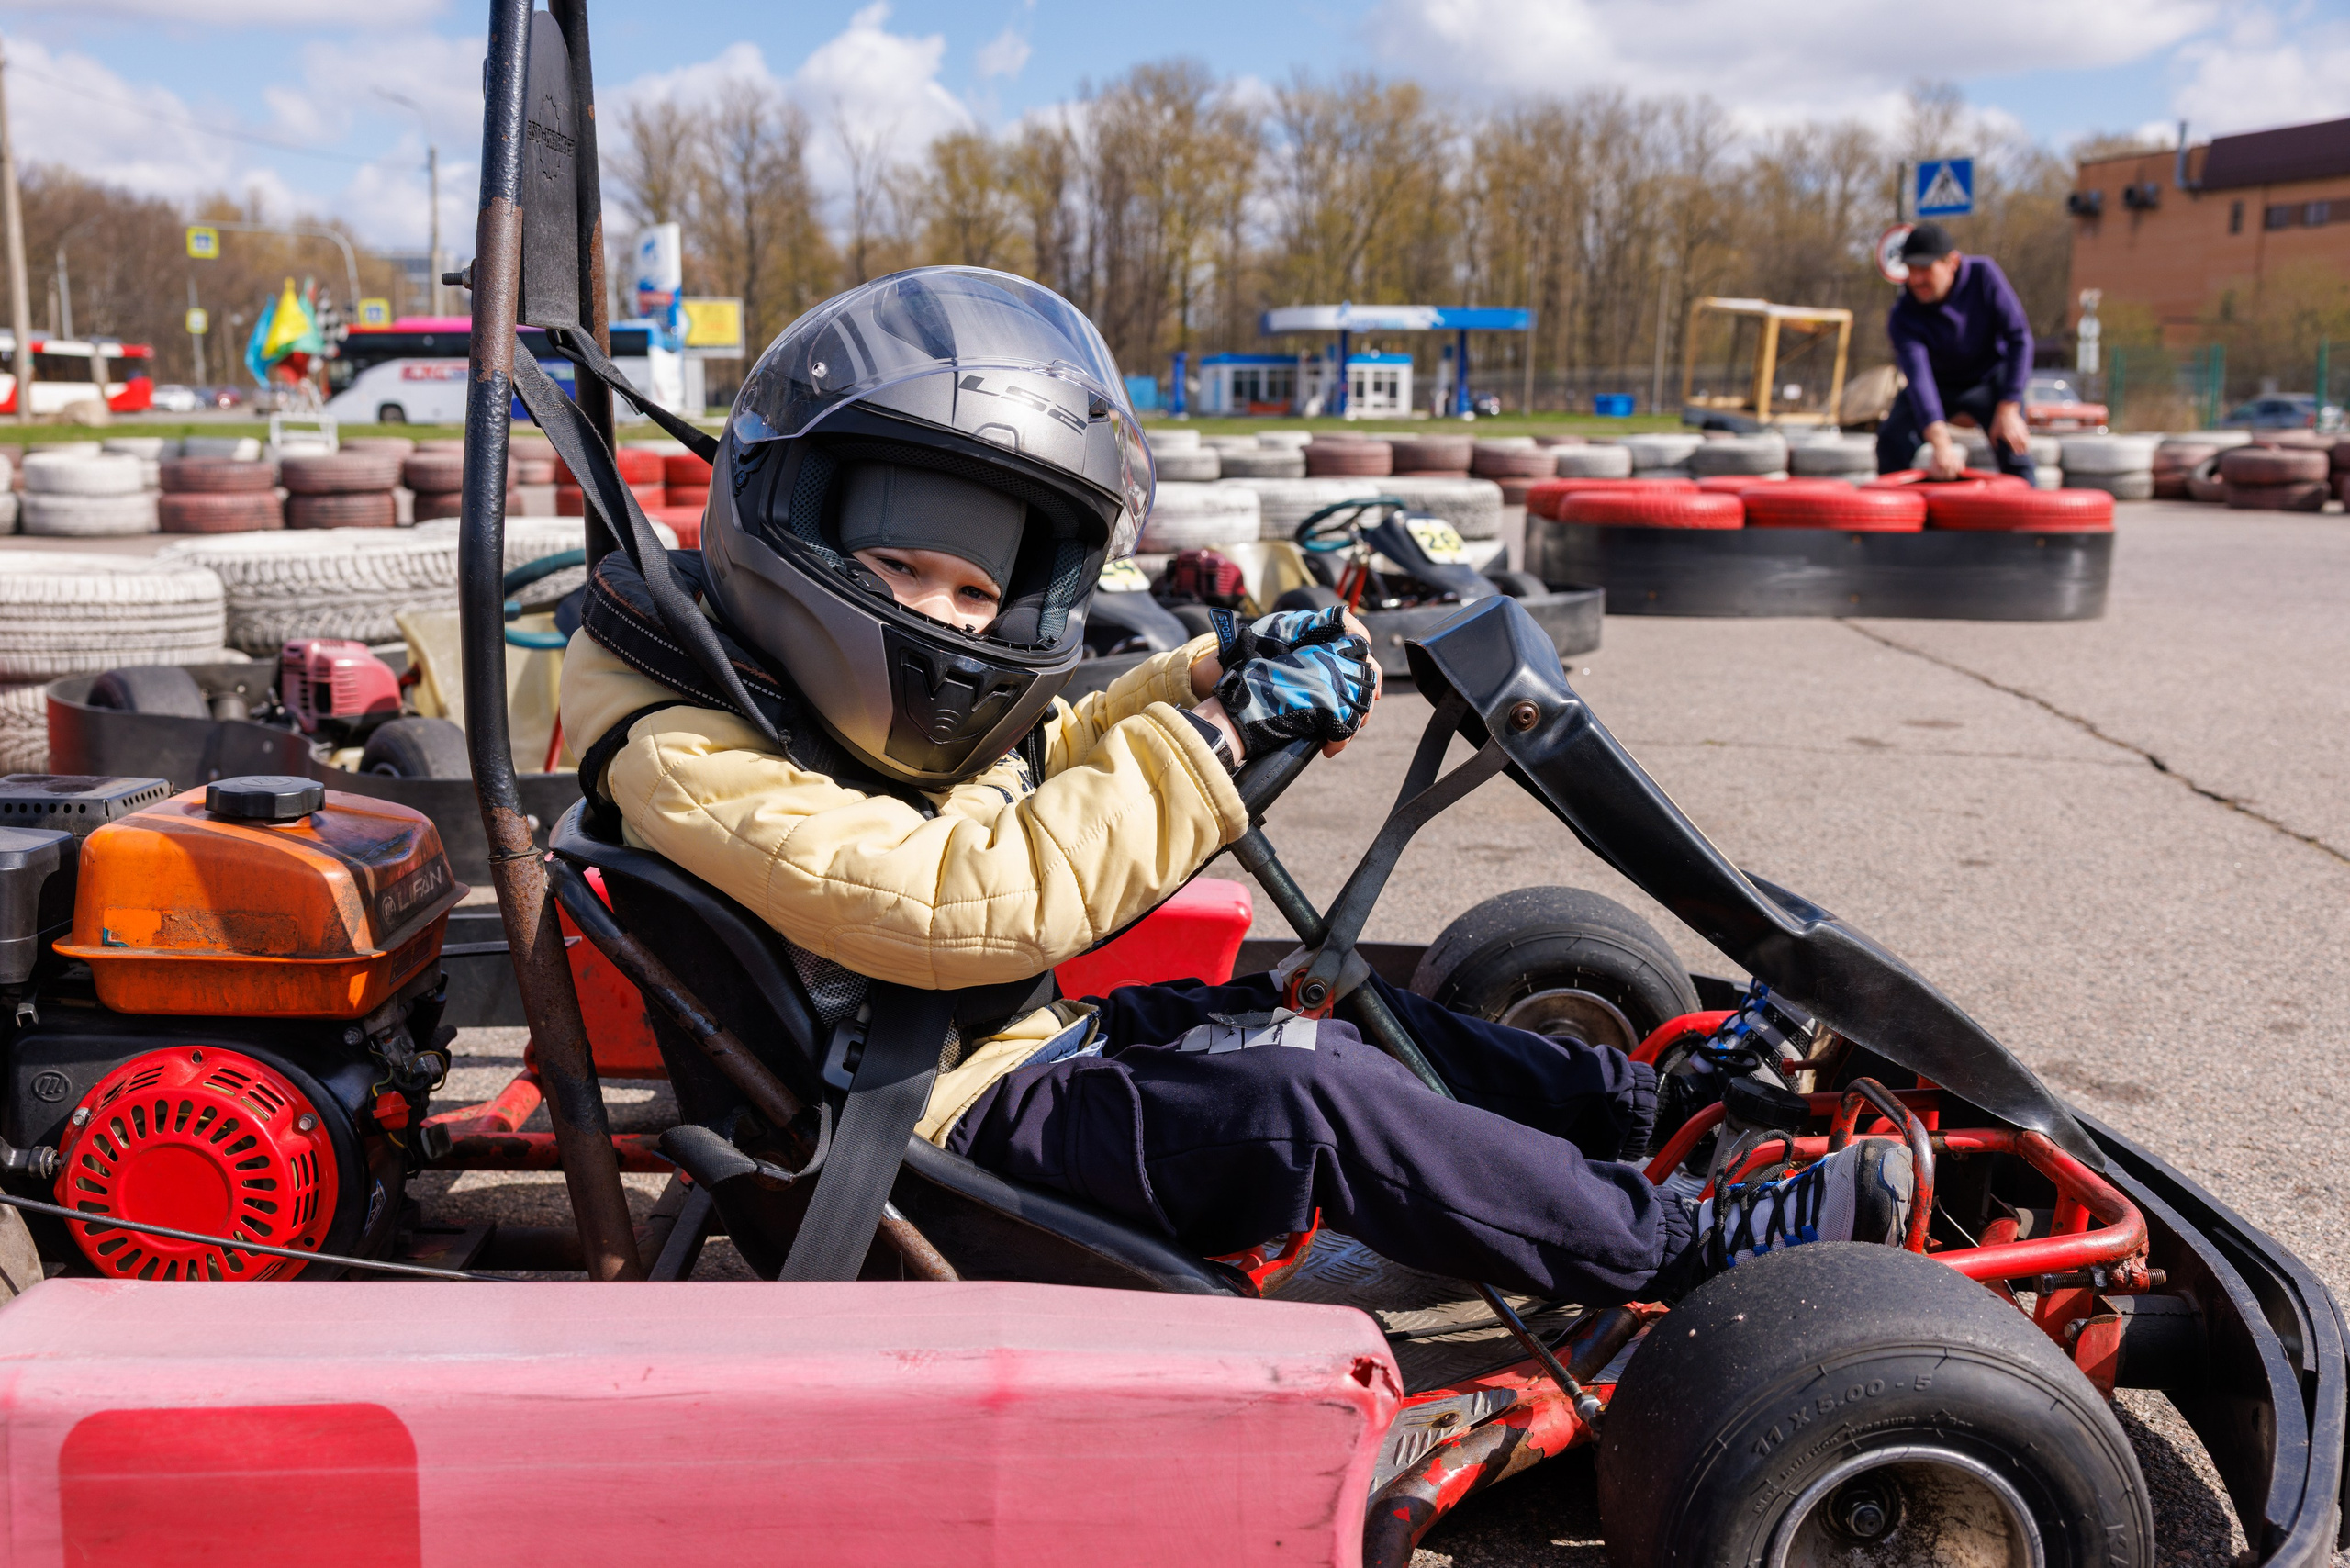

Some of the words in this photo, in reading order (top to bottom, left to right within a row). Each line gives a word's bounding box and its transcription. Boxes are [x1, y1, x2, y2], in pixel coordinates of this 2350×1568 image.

[958, 375, 1088, 436] LS2
[1419, 529, 1462, 552] 26
[1218, 614, 1232, 644] SPORT
[397, 865, 442, 912] LIFAN
[1751, 1424, 1785, 1455] 11
[1789, 1406, 1811, 1431] X
[1816, 1378, 1886, 1415] 5.00
[1914, 1374, 1932, 1392] 5
